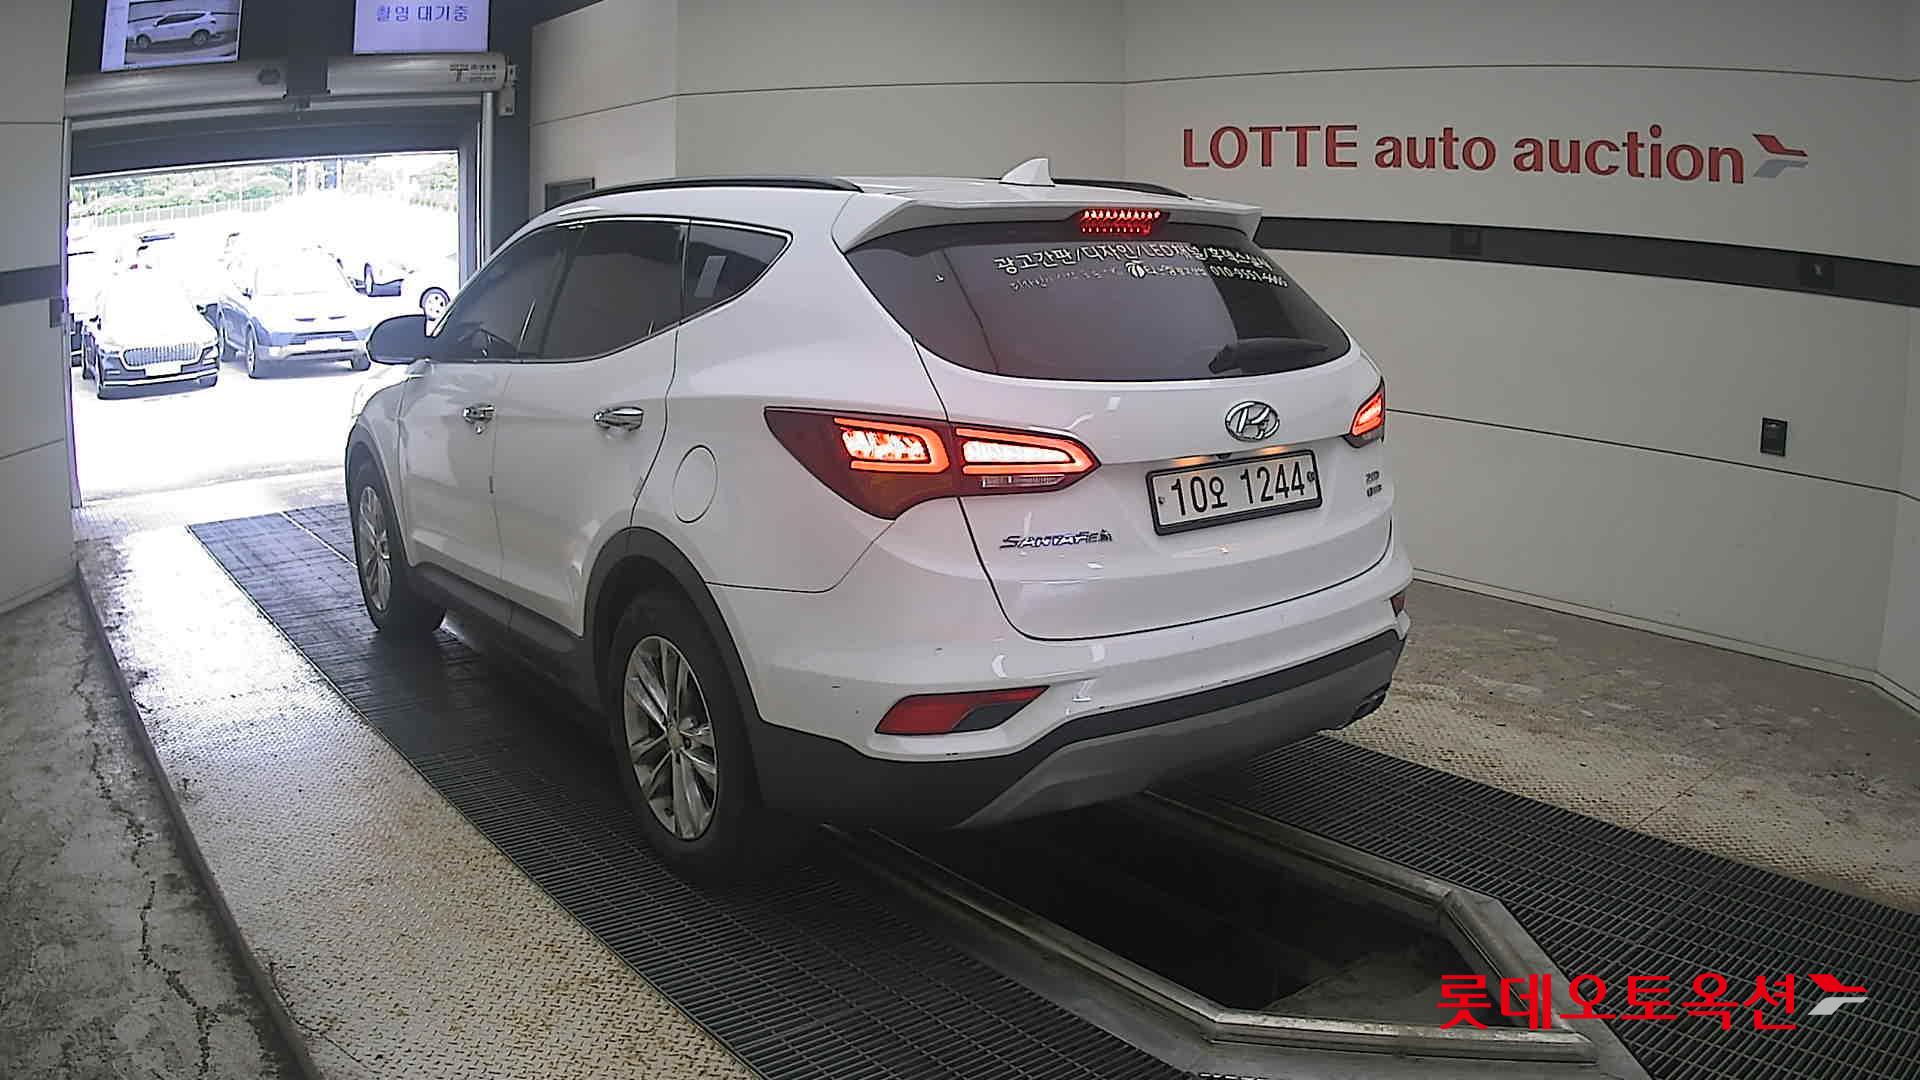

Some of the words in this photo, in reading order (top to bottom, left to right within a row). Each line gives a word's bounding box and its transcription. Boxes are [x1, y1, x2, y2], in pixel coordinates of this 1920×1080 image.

[417, 5, 469, 22] 대기중
[1183, 124, 1358, 169] LOTTE
[1374, 126, 1497, 171] auto
[1513, 123, 1745, 184] auction
[1170, 476, 1228, 516] 10오
[1239, 461, 1305, 504] 1244
